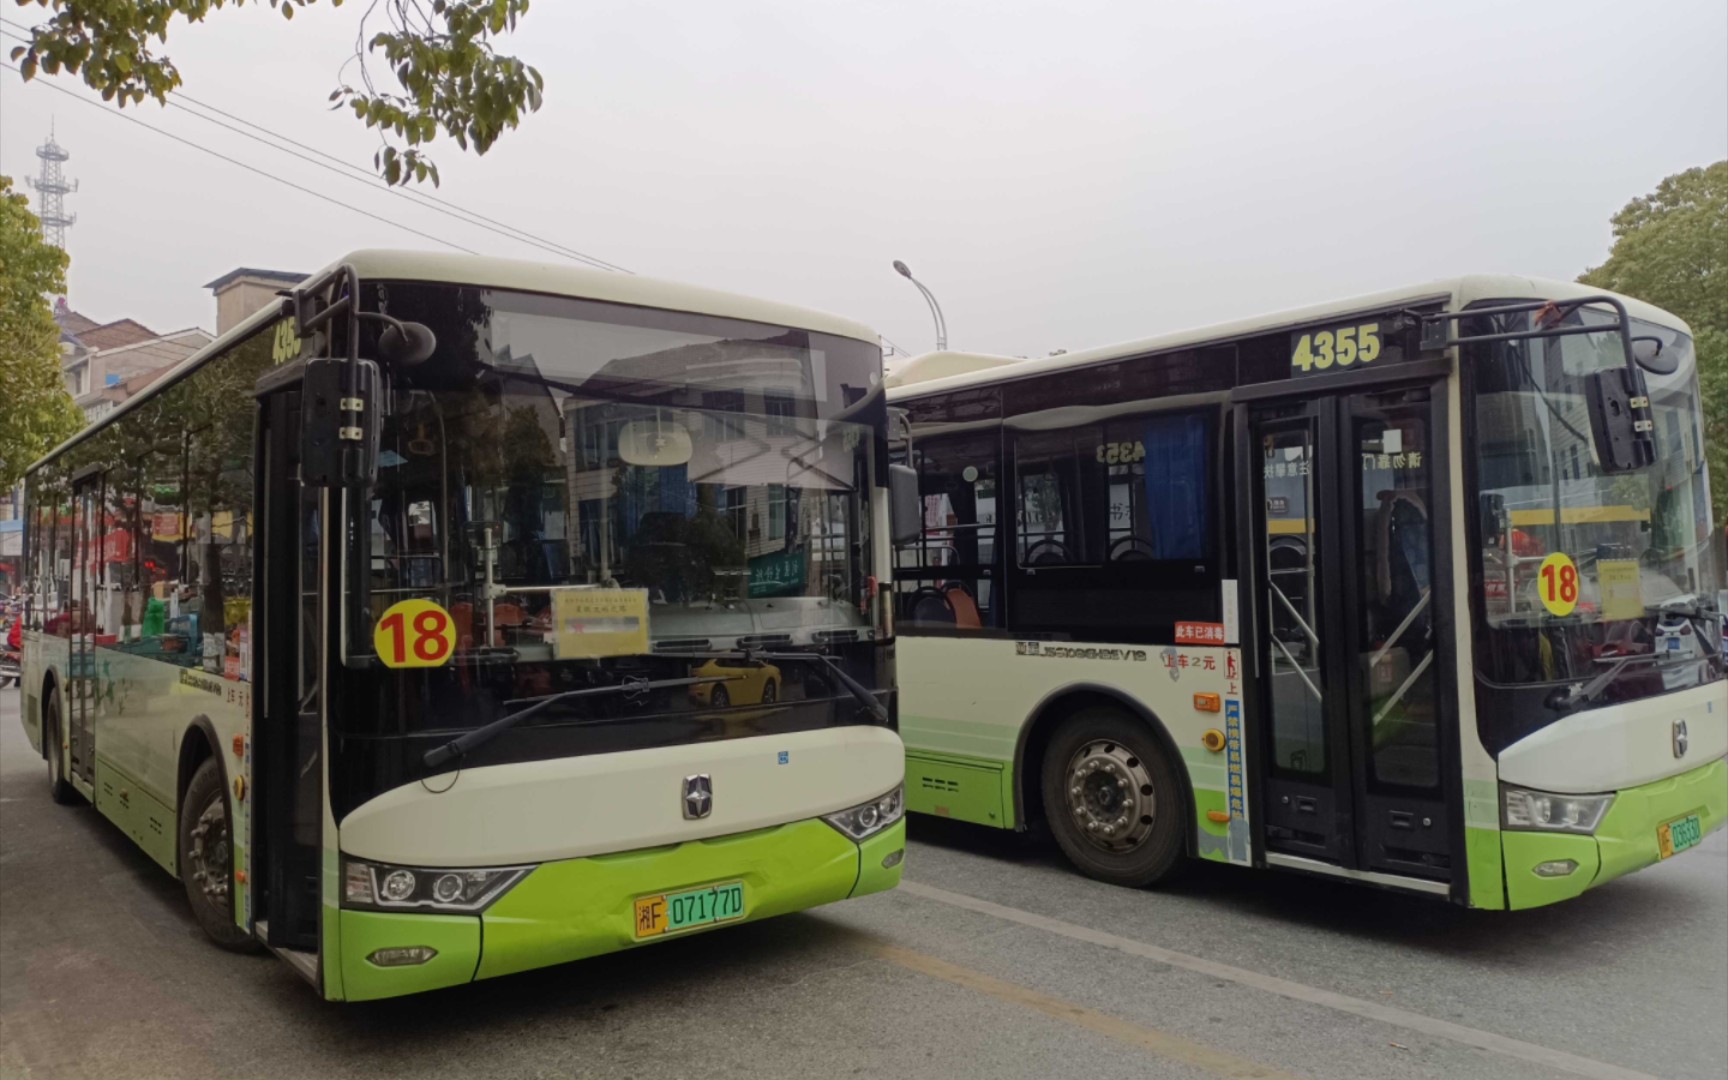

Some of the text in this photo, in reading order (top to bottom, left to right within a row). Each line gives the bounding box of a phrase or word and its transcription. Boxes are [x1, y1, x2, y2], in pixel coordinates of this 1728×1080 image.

[1292, 323, 1380, 371] 4355
[1541, 564, 1577, 603] 18
[381, 610, 449, 663] 18
[1175, 625, 1225, 640] 此车已消毒
[672, 887, 742, 925] 07177D
